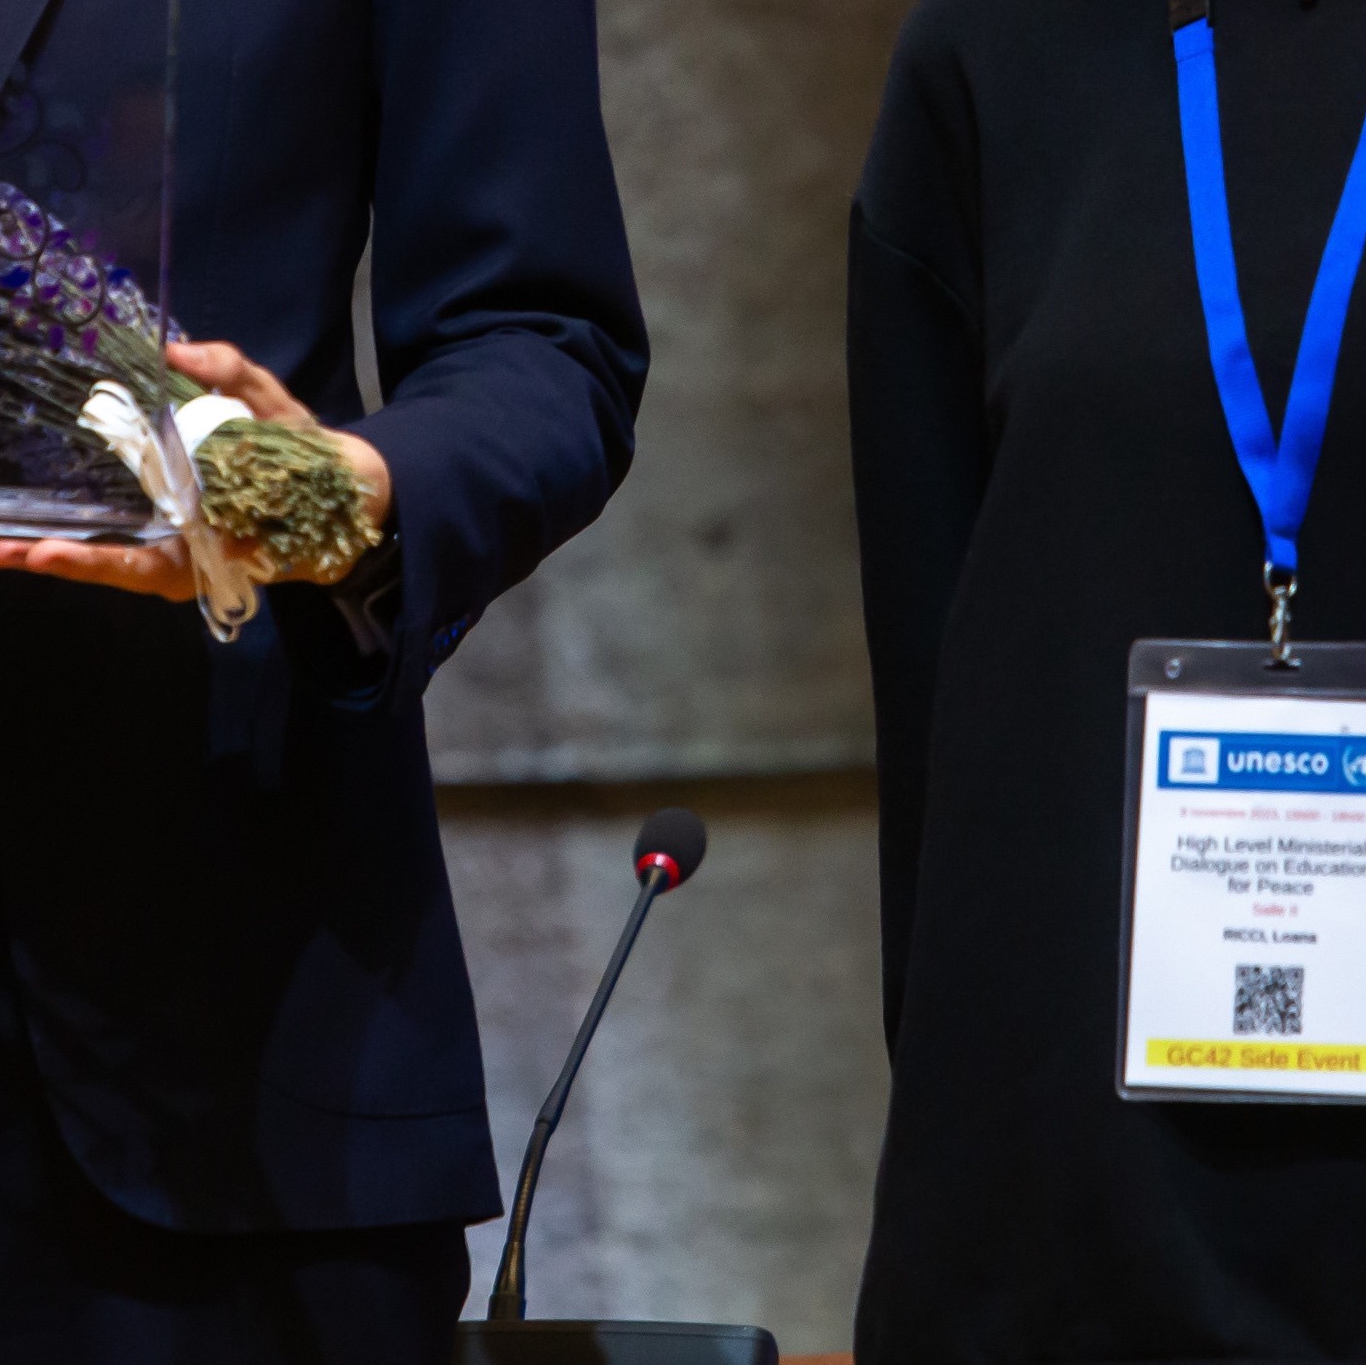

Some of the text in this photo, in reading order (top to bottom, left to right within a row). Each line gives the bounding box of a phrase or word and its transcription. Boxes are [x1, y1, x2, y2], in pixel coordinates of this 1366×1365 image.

[1227, 750, 1329, 775] unesco
[1178, 836, 1218, 858] High
[1224, 836, 1272, 853] Level
[1170, 854, 1250, 877] Dialogue
[1255, 860, 1278, 874] on
[1228, 876, 1315, 895] for Peace
[1166, 1044, 1362, 1072] GC42 Side Event
